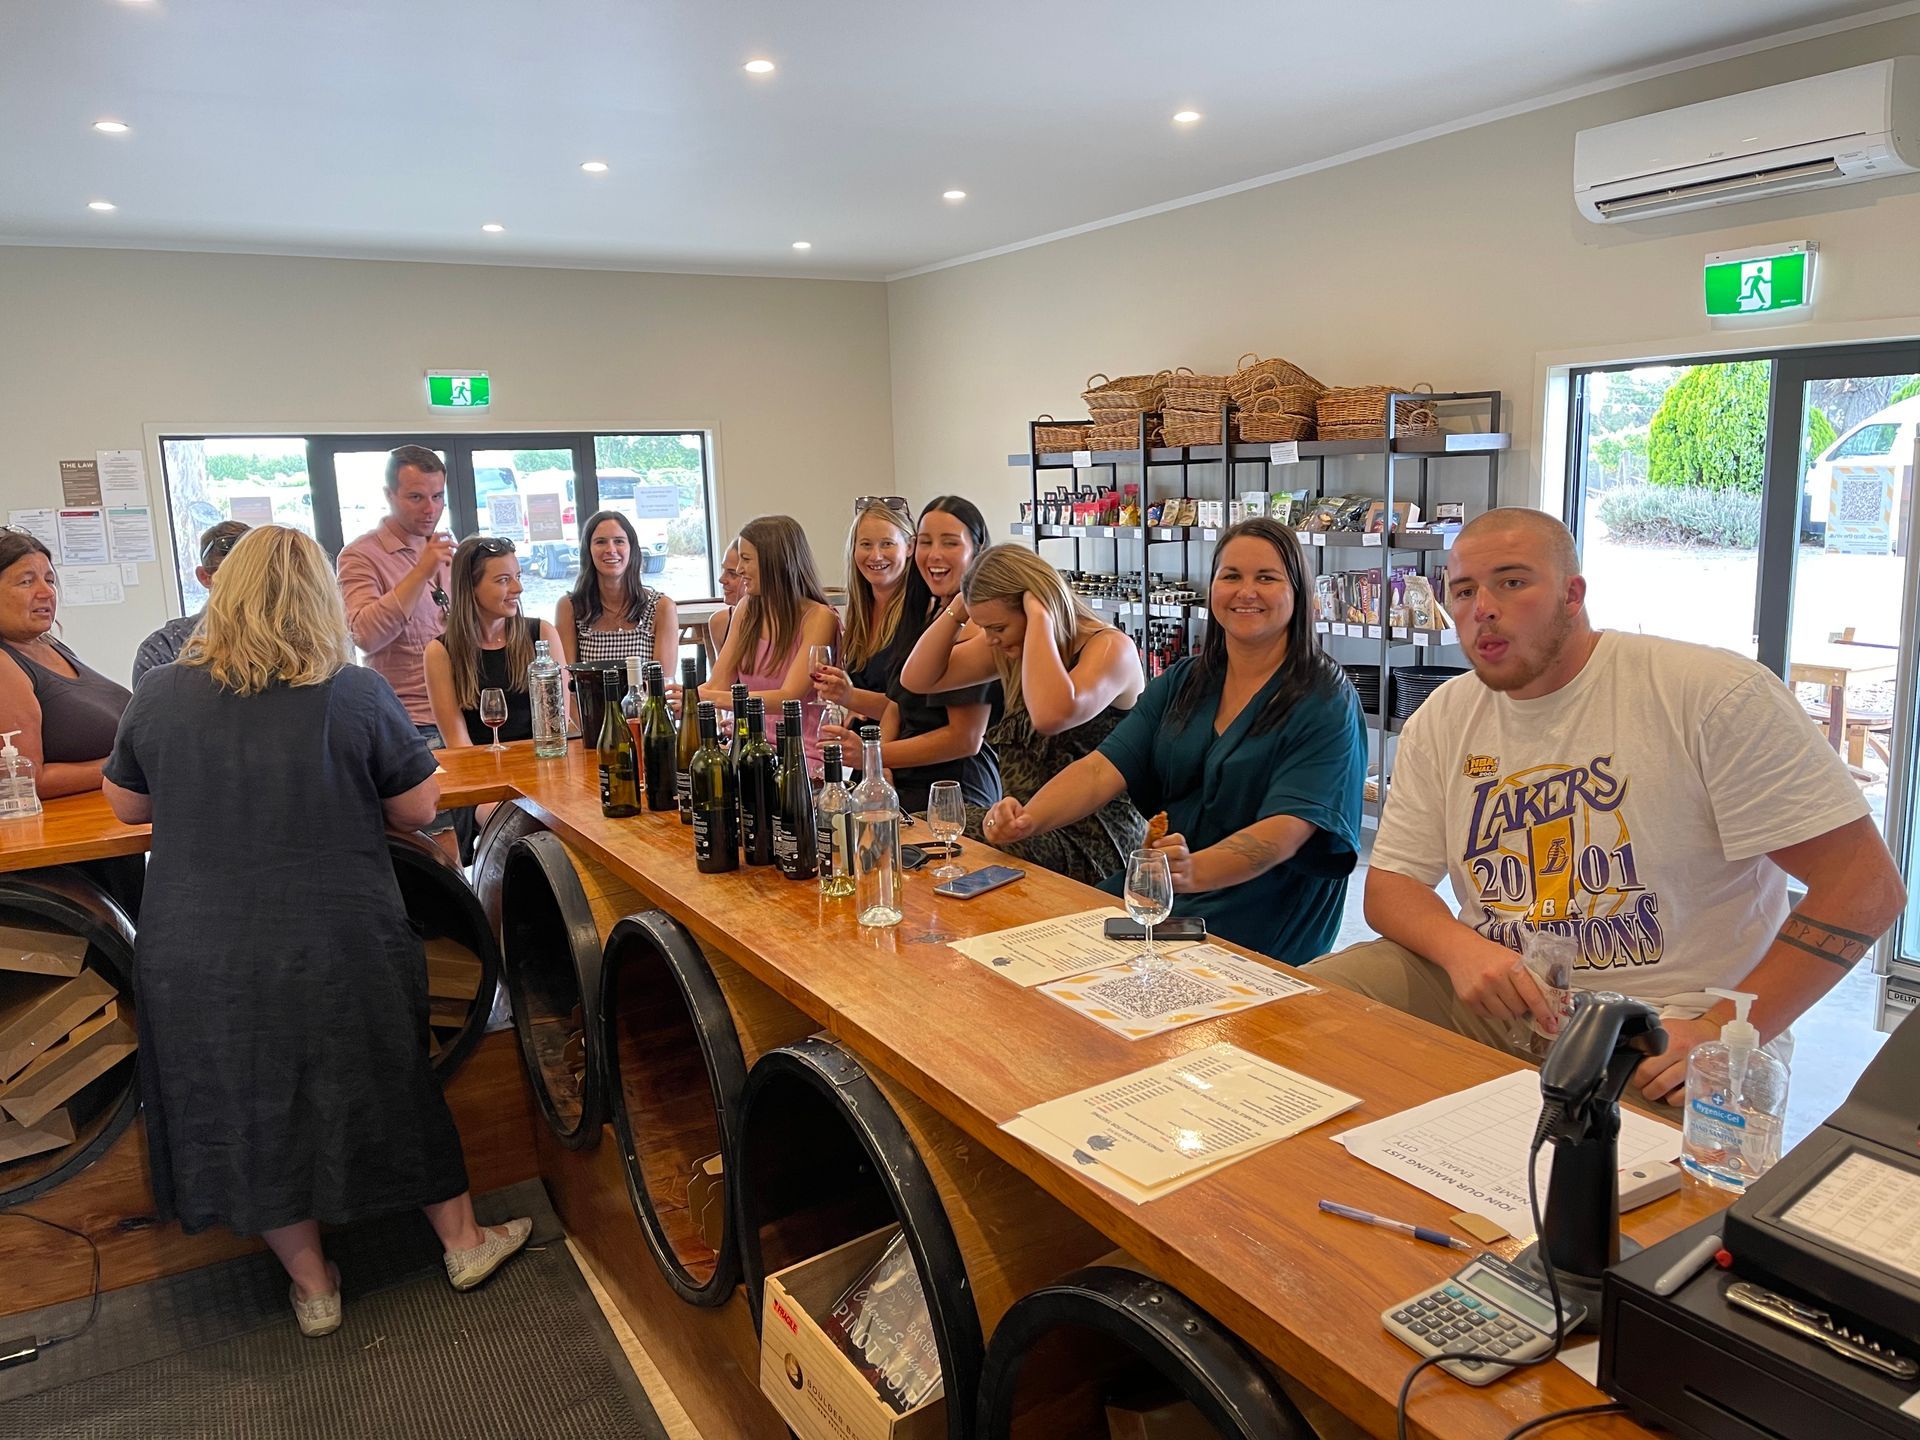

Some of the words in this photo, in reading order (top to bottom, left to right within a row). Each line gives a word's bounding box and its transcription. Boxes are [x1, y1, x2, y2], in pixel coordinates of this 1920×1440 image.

[1463, 753, 1629, 862] LAKERS
[1525, 898, 1583, 918] NBA
[1894, 991, 1918, 1005] DELTA
[1382, 1148, 1407, 1161] LIST
[1393, 1140, 1419, 1152] CITY
[1405, 1159, 1458, 1185] MAILING
[1439, 1160, 1474, 1178] EMAIL
[1456, 1184, 1485, 1198] OUR
[1484, 1197, 1516, 1212] JOIN
[777, 1305, 798, 1332] FRAGILE
[853, 1290, 891, 1334] Cabernet
[832, 1303, 882, 1364] PINOT
[875, 1358, 918, 1410] NOIR
[906, 1322, 940, 1368] BARBER
[807, 1379, 844, 1426] BOULDER
